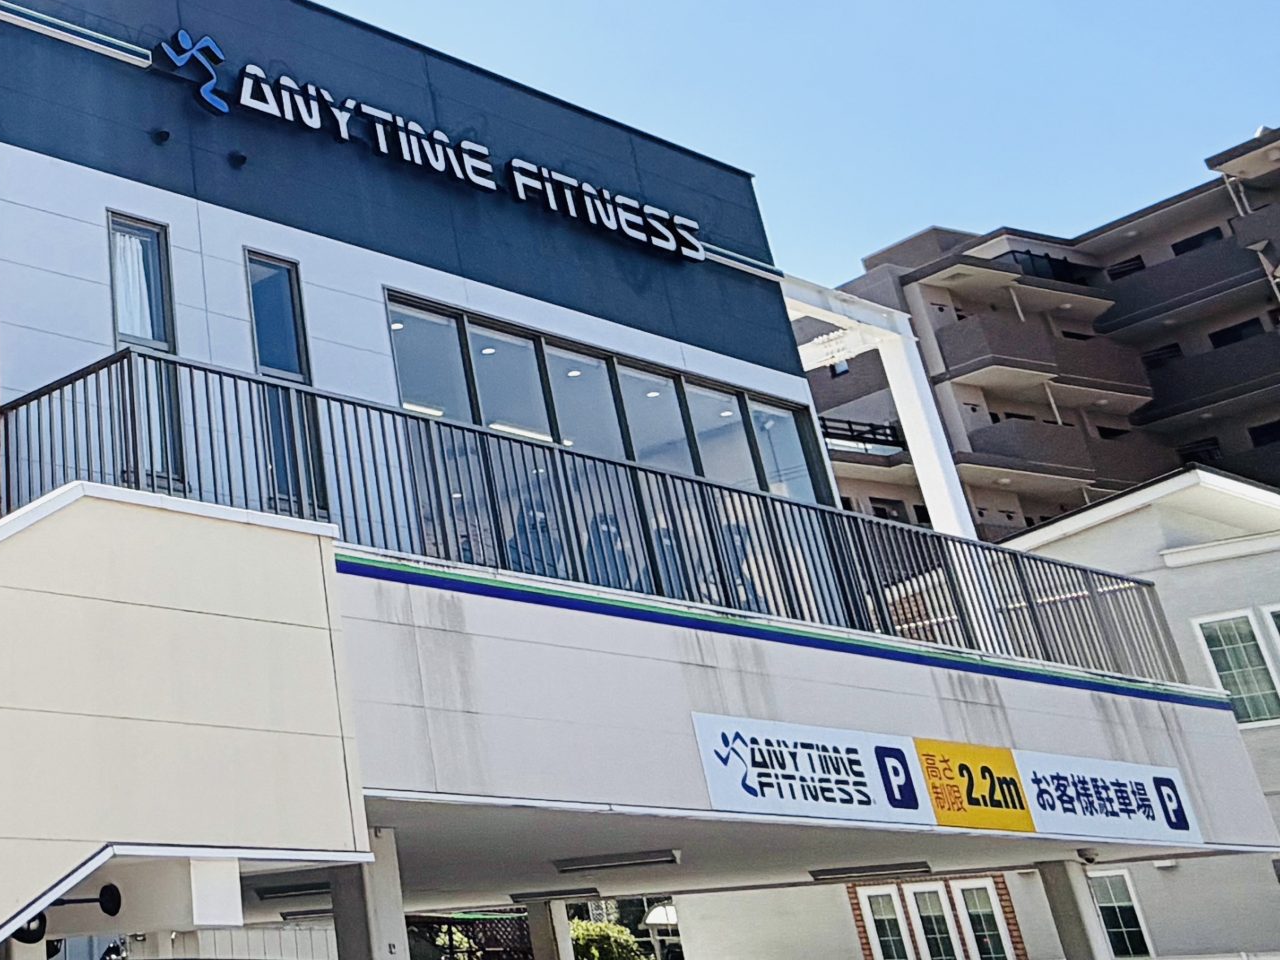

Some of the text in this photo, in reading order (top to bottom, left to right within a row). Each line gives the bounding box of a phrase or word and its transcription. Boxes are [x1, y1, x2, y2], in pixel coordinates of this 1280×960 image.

[921, 752, 955, 781] 高さ
[958, 762, 1025, 810] 2.2m
[931, 782, 967, 813] 制限
[1031, 770, 1156, 822] お客様駐車場
